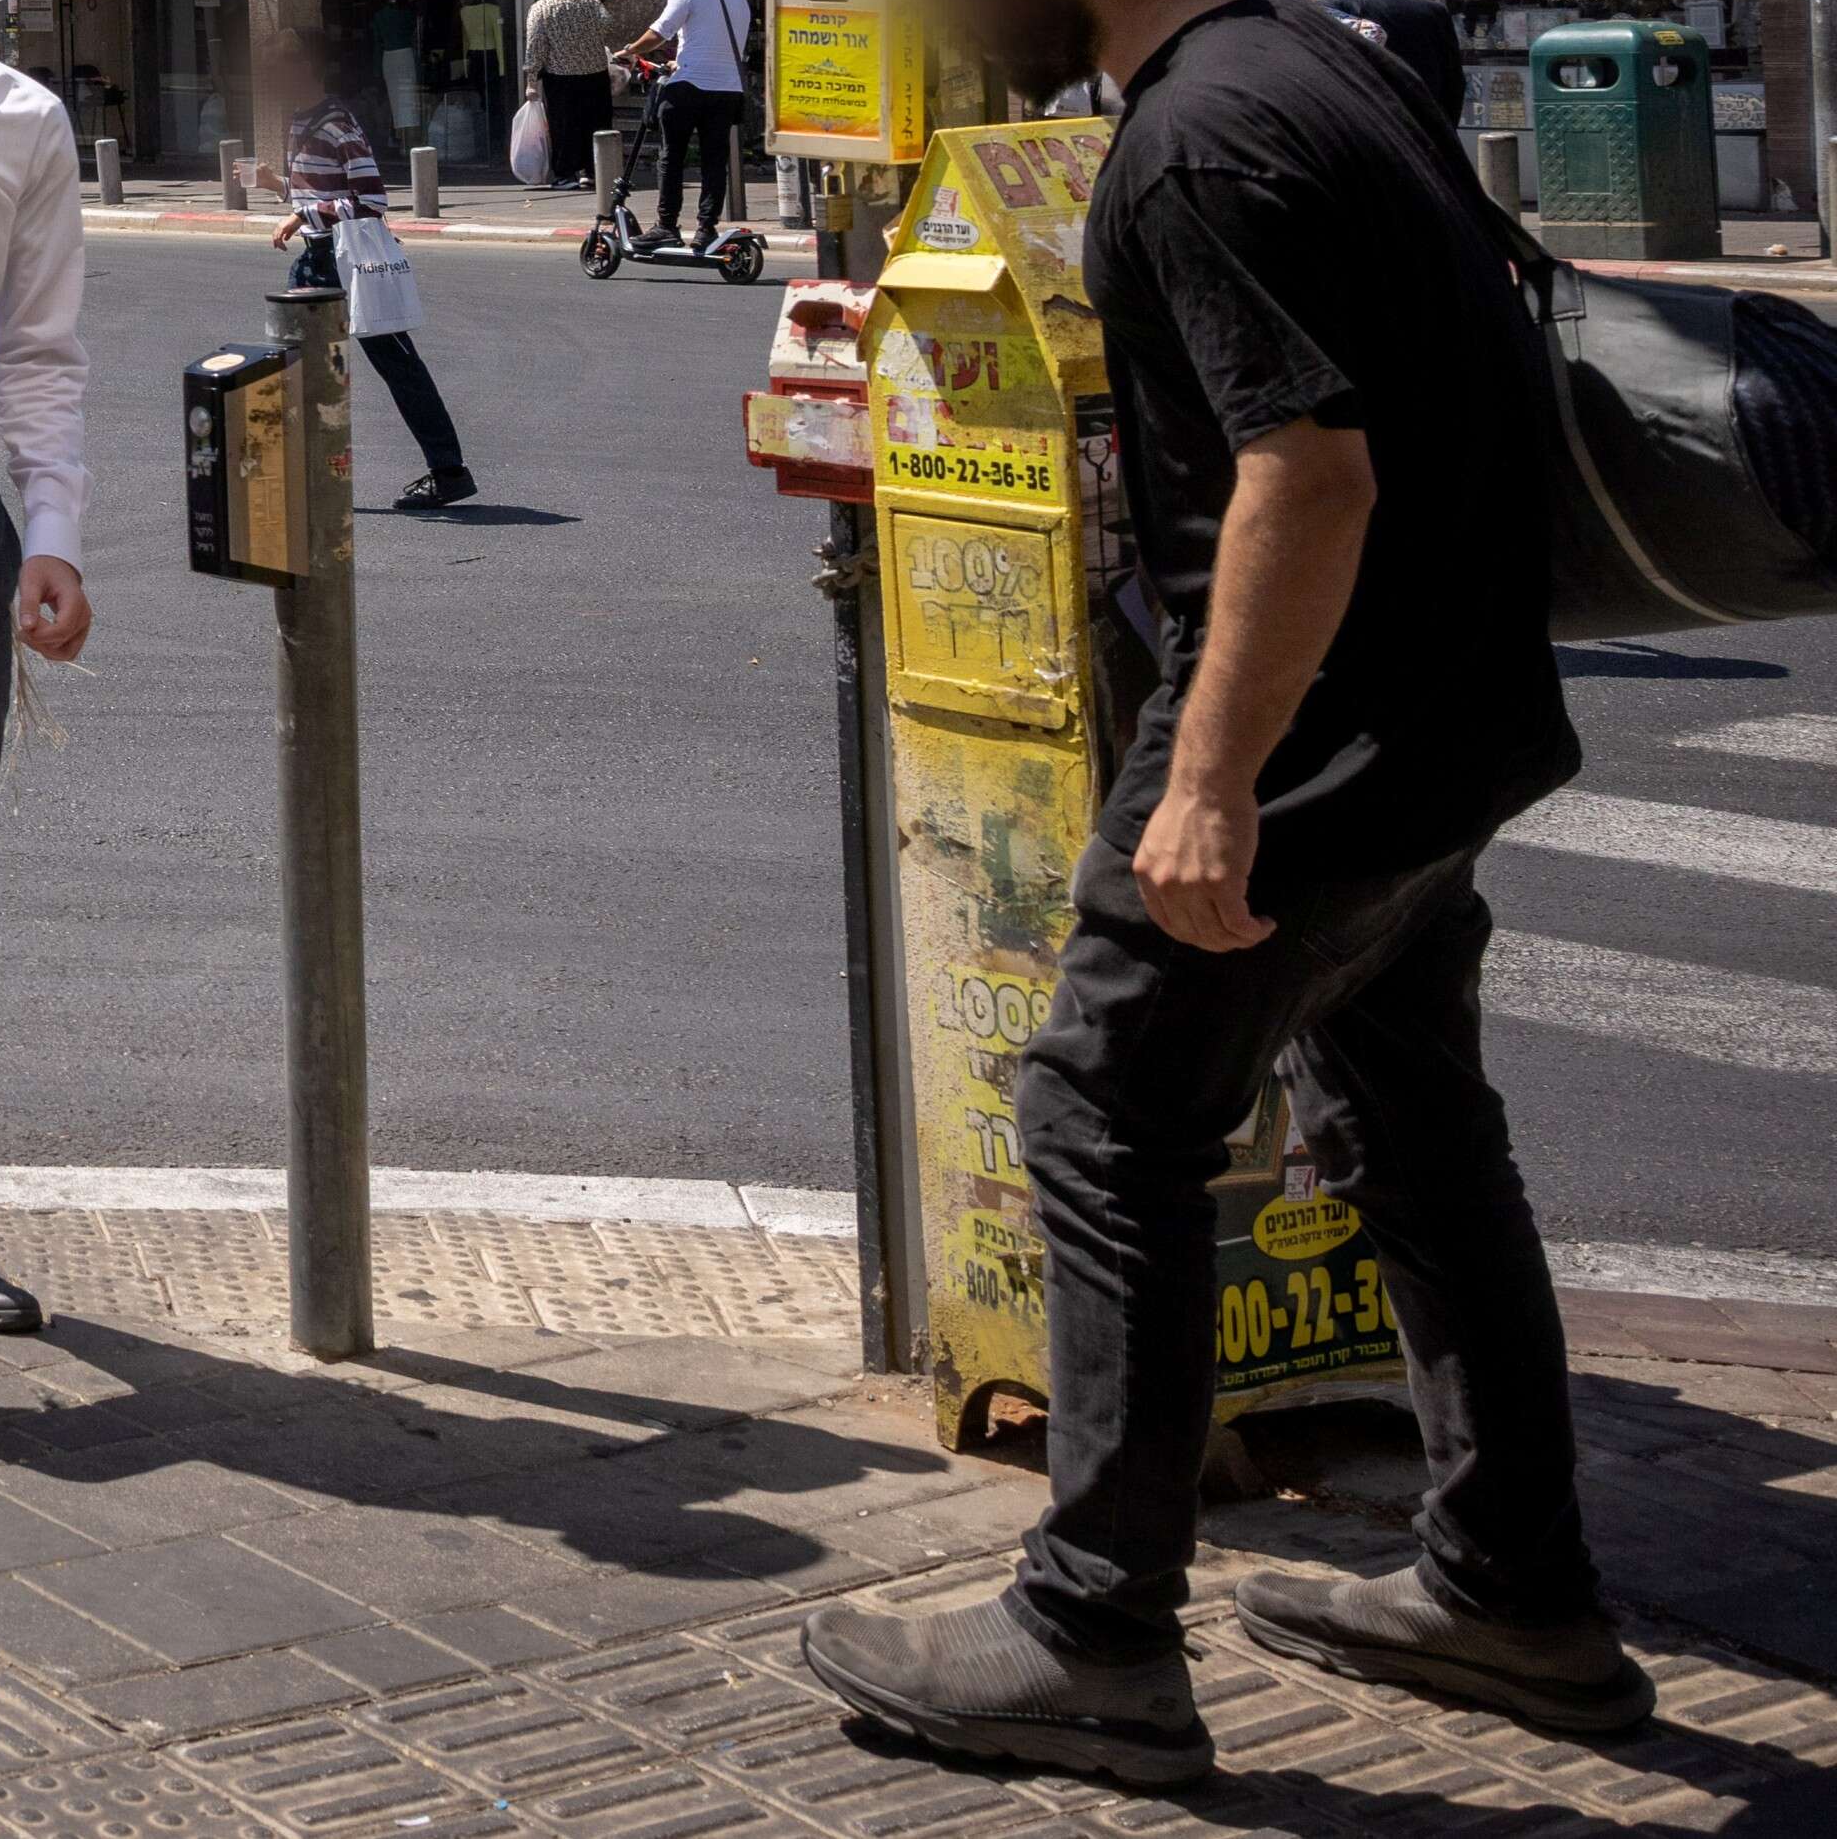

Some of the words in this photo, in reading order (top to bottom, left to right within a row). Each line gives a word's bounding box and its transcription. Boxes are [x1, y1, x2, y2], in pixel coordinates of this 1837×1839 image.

[809, 13, 848, 28] קופת
[788, 29, 838, 48] ושמחה
[842, 33, 869, 49] אור
[789, 77, 822, 91] בסתר
[825, 81, 866, 94] תמיכה
[922, 221, 954, 234] הרבנים
[888, 449, 1052, 493] 1-800-22-36-36
[906, 535, 1043, 600] 100%
[1264, 1204, 1318, 1235] הרבנים
[1320, 1202, 1350, 1223] ועד
[1215, 1258, 1399, 1365] 00-22-3
[1354, 1339, 1391, 1357] עבור
